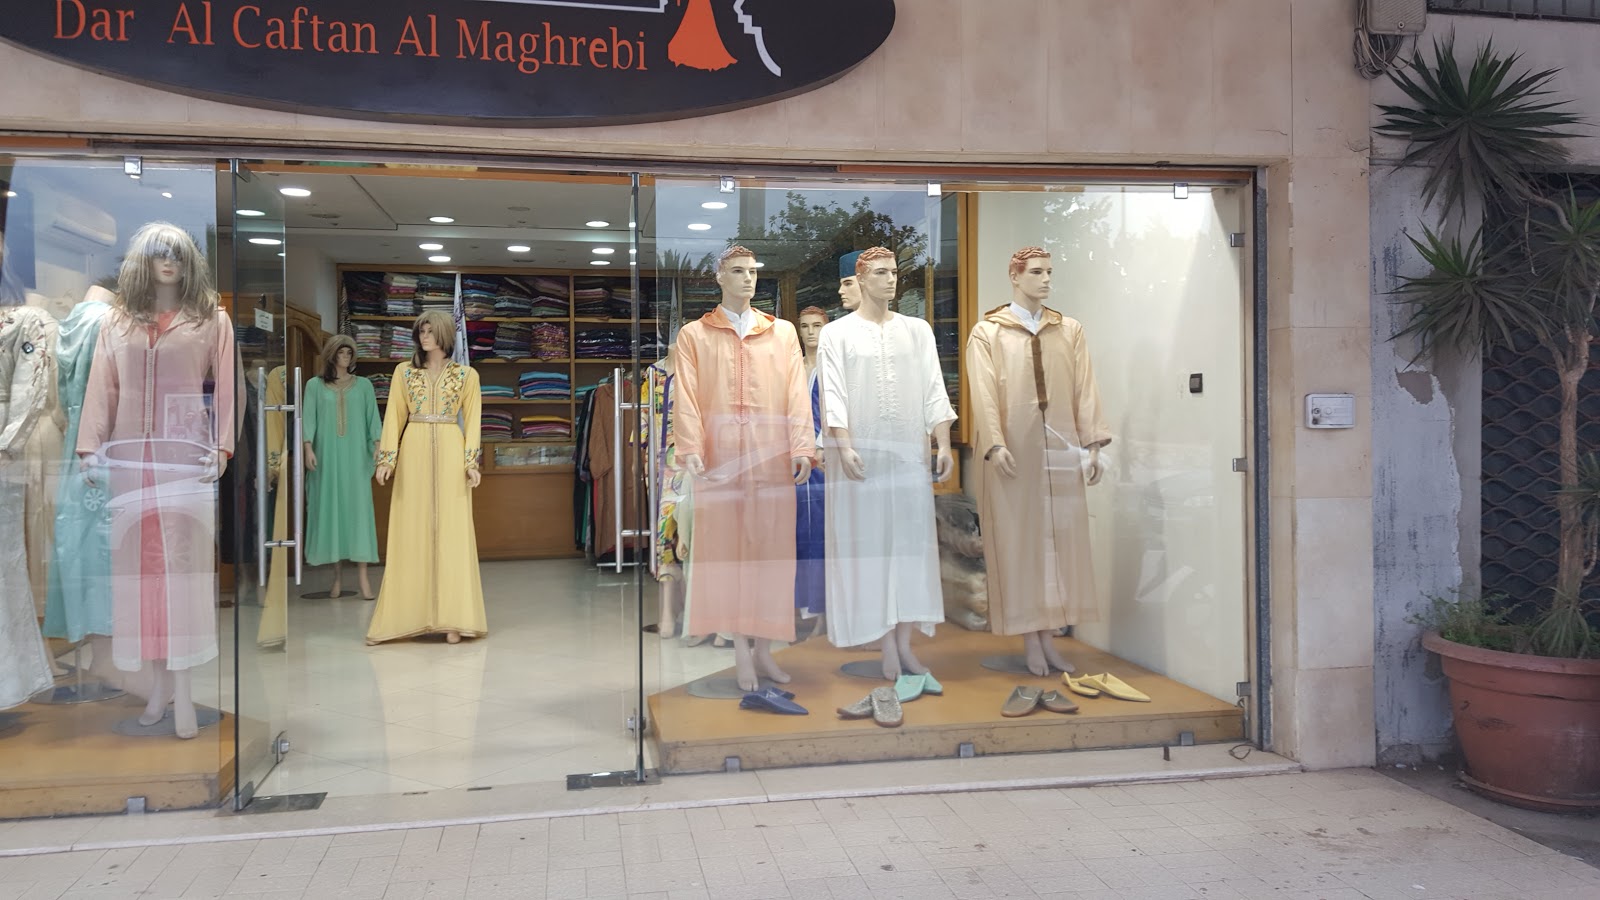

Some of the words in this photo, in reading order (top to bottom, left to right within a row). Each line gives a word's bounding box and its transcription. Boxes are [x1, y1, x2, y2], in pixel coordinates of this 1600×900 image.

[54, 0, 135, 42] Dar
[167, 1, 214, 45] Al
[232, 6, 379, 54] Caftan
[394, 14, 440, 58] Al
[455, 18, 648, 74] Maghrebi
